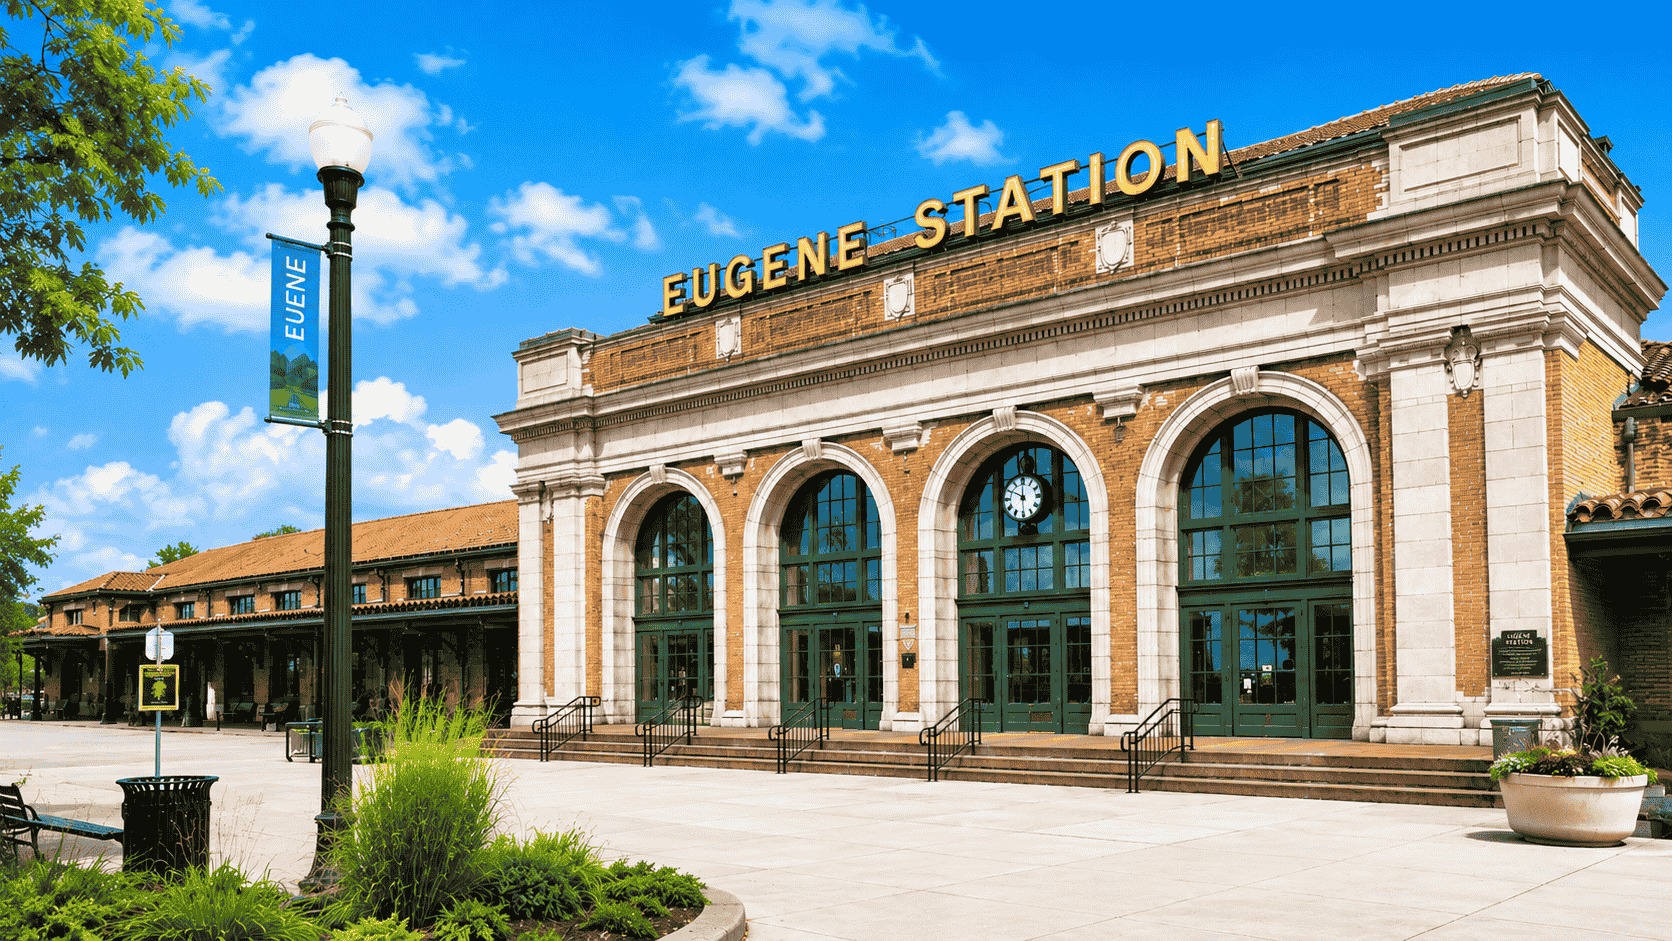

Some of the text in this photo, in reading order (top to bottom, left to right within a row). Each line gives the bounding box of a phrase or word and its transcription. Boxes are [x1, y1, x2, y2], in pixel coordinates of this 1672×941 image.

[663, 119, 1223, 317] EUGENE STATION
[285, 256, 306, 341] EUENE
